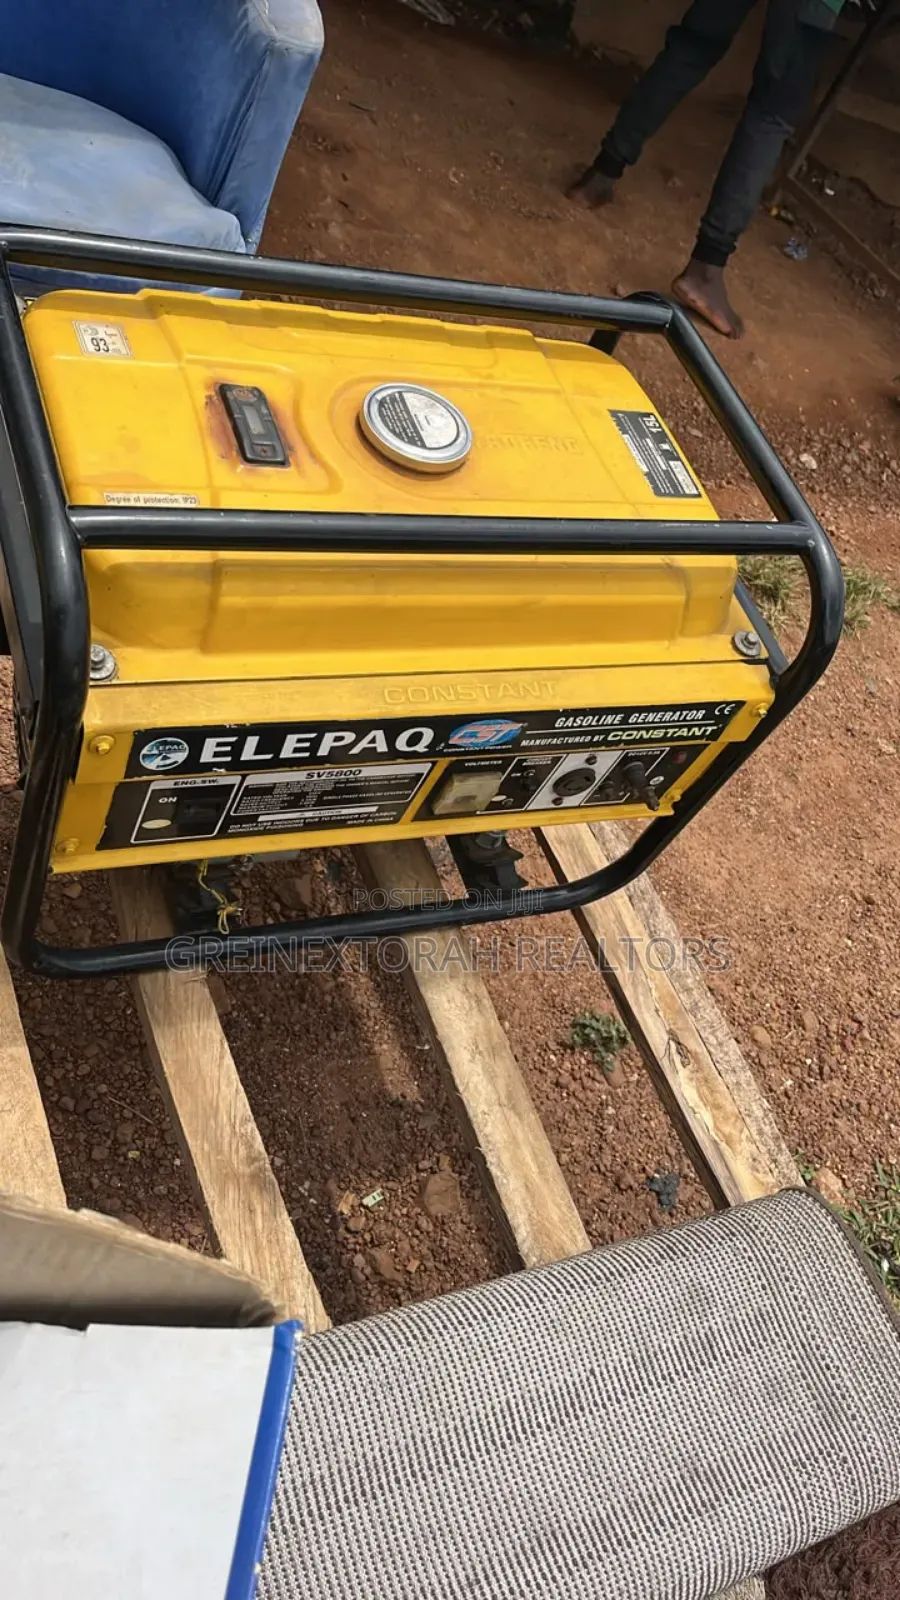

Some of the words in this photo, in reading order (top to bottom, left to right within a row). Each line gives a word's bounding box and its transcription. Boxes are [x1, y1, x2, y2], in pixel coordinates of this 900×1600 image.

[90, 337, 110, 353] 93
[642, 414, 662, 433] 15L
[105, 494, 131, 505] Degree
[133, 496, 141, 504] of
[383, 681, 557, 704] CONSTANT
[555, 714, 624, 728] GASOLINE
[628, 710, 706, 724] GENERATOR
[200, 727, 434, 763] ELEPAQ
[520, 736, 591, 747] MANUFACTURED
[593, 734, 606, 742] BY
[607, 726, 717, 742] CONSTANT
[305, 769, 362, 780] SV5800
